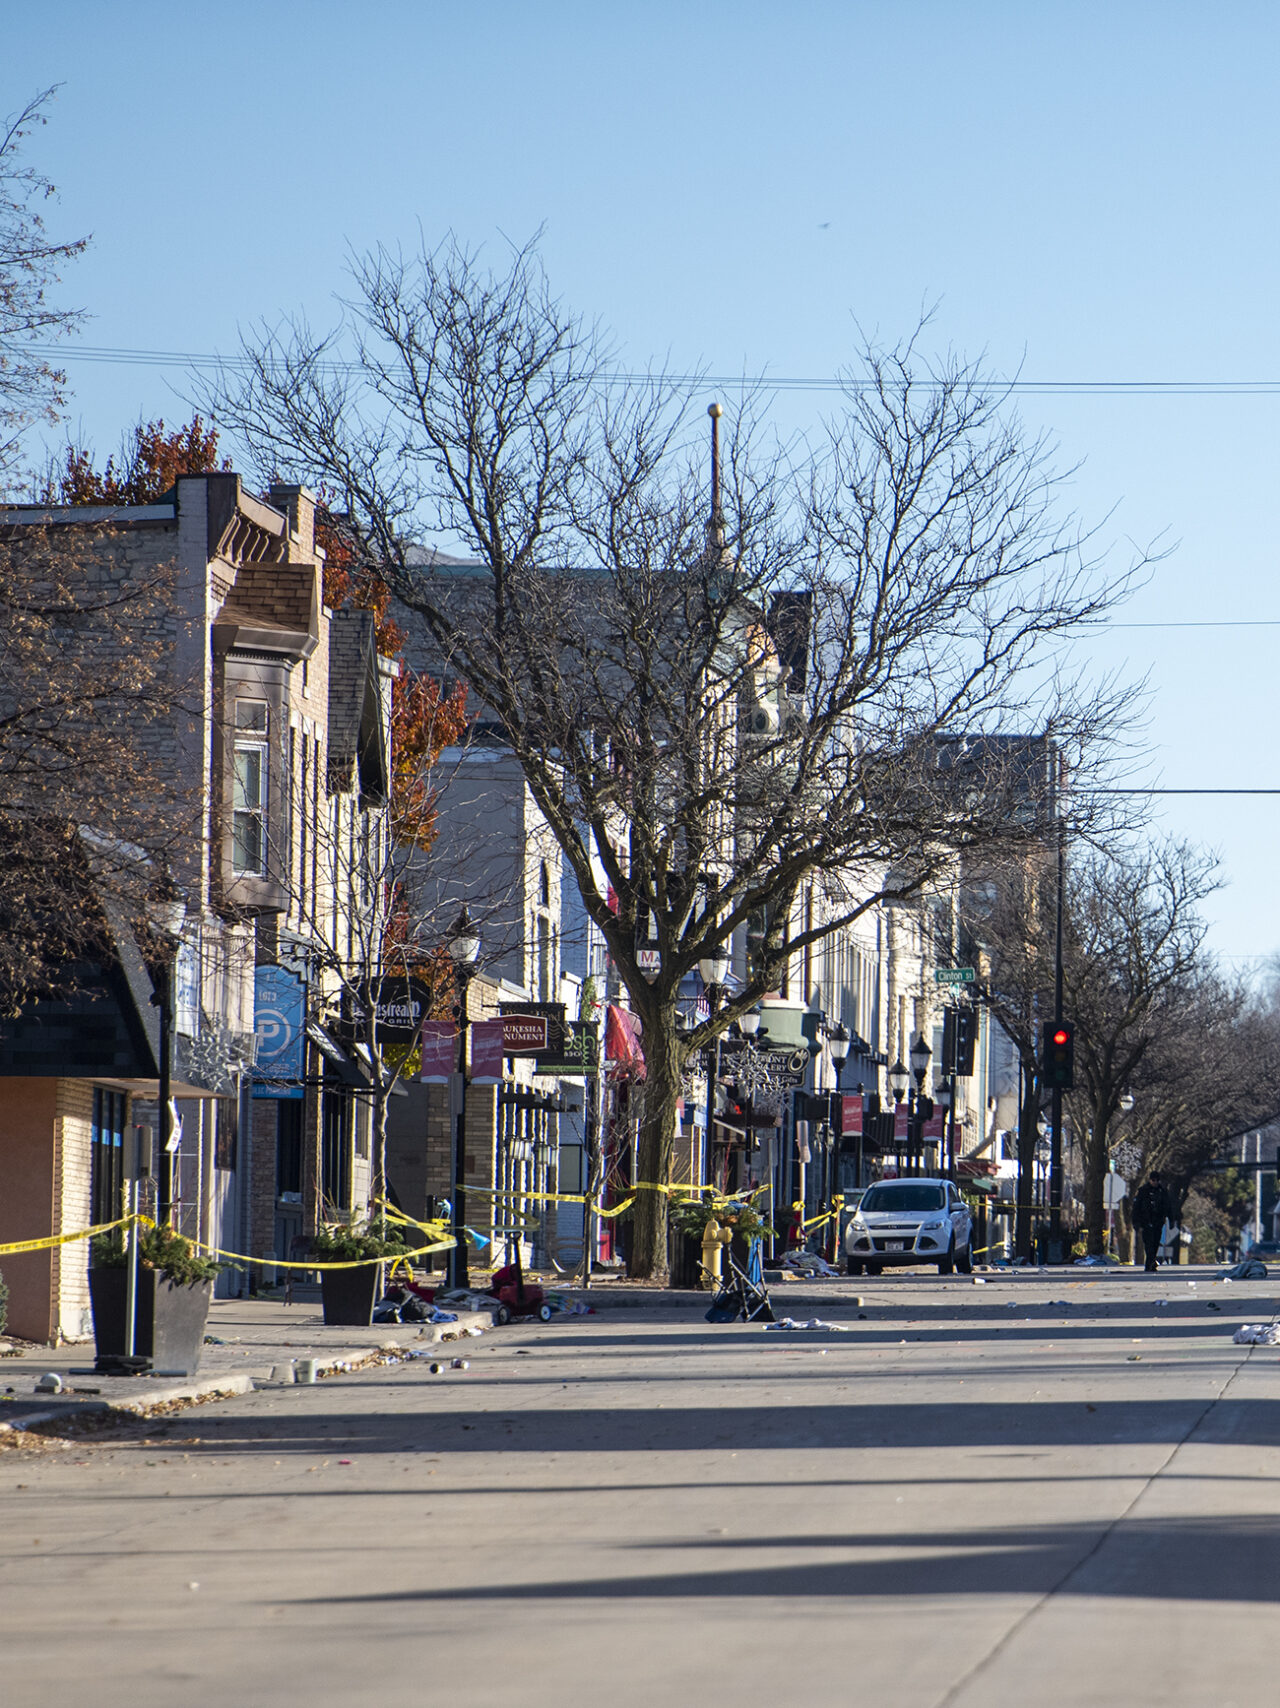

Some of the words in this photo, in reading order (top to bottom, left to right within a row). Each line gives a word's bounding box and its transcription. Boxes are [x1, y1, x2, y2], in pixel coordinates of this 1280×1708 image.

[938, 972, 963, 981] Clinton
[502, 1025, 543, 1033] UKESHA
[503, 1032, 545, 1041] NUMENT
